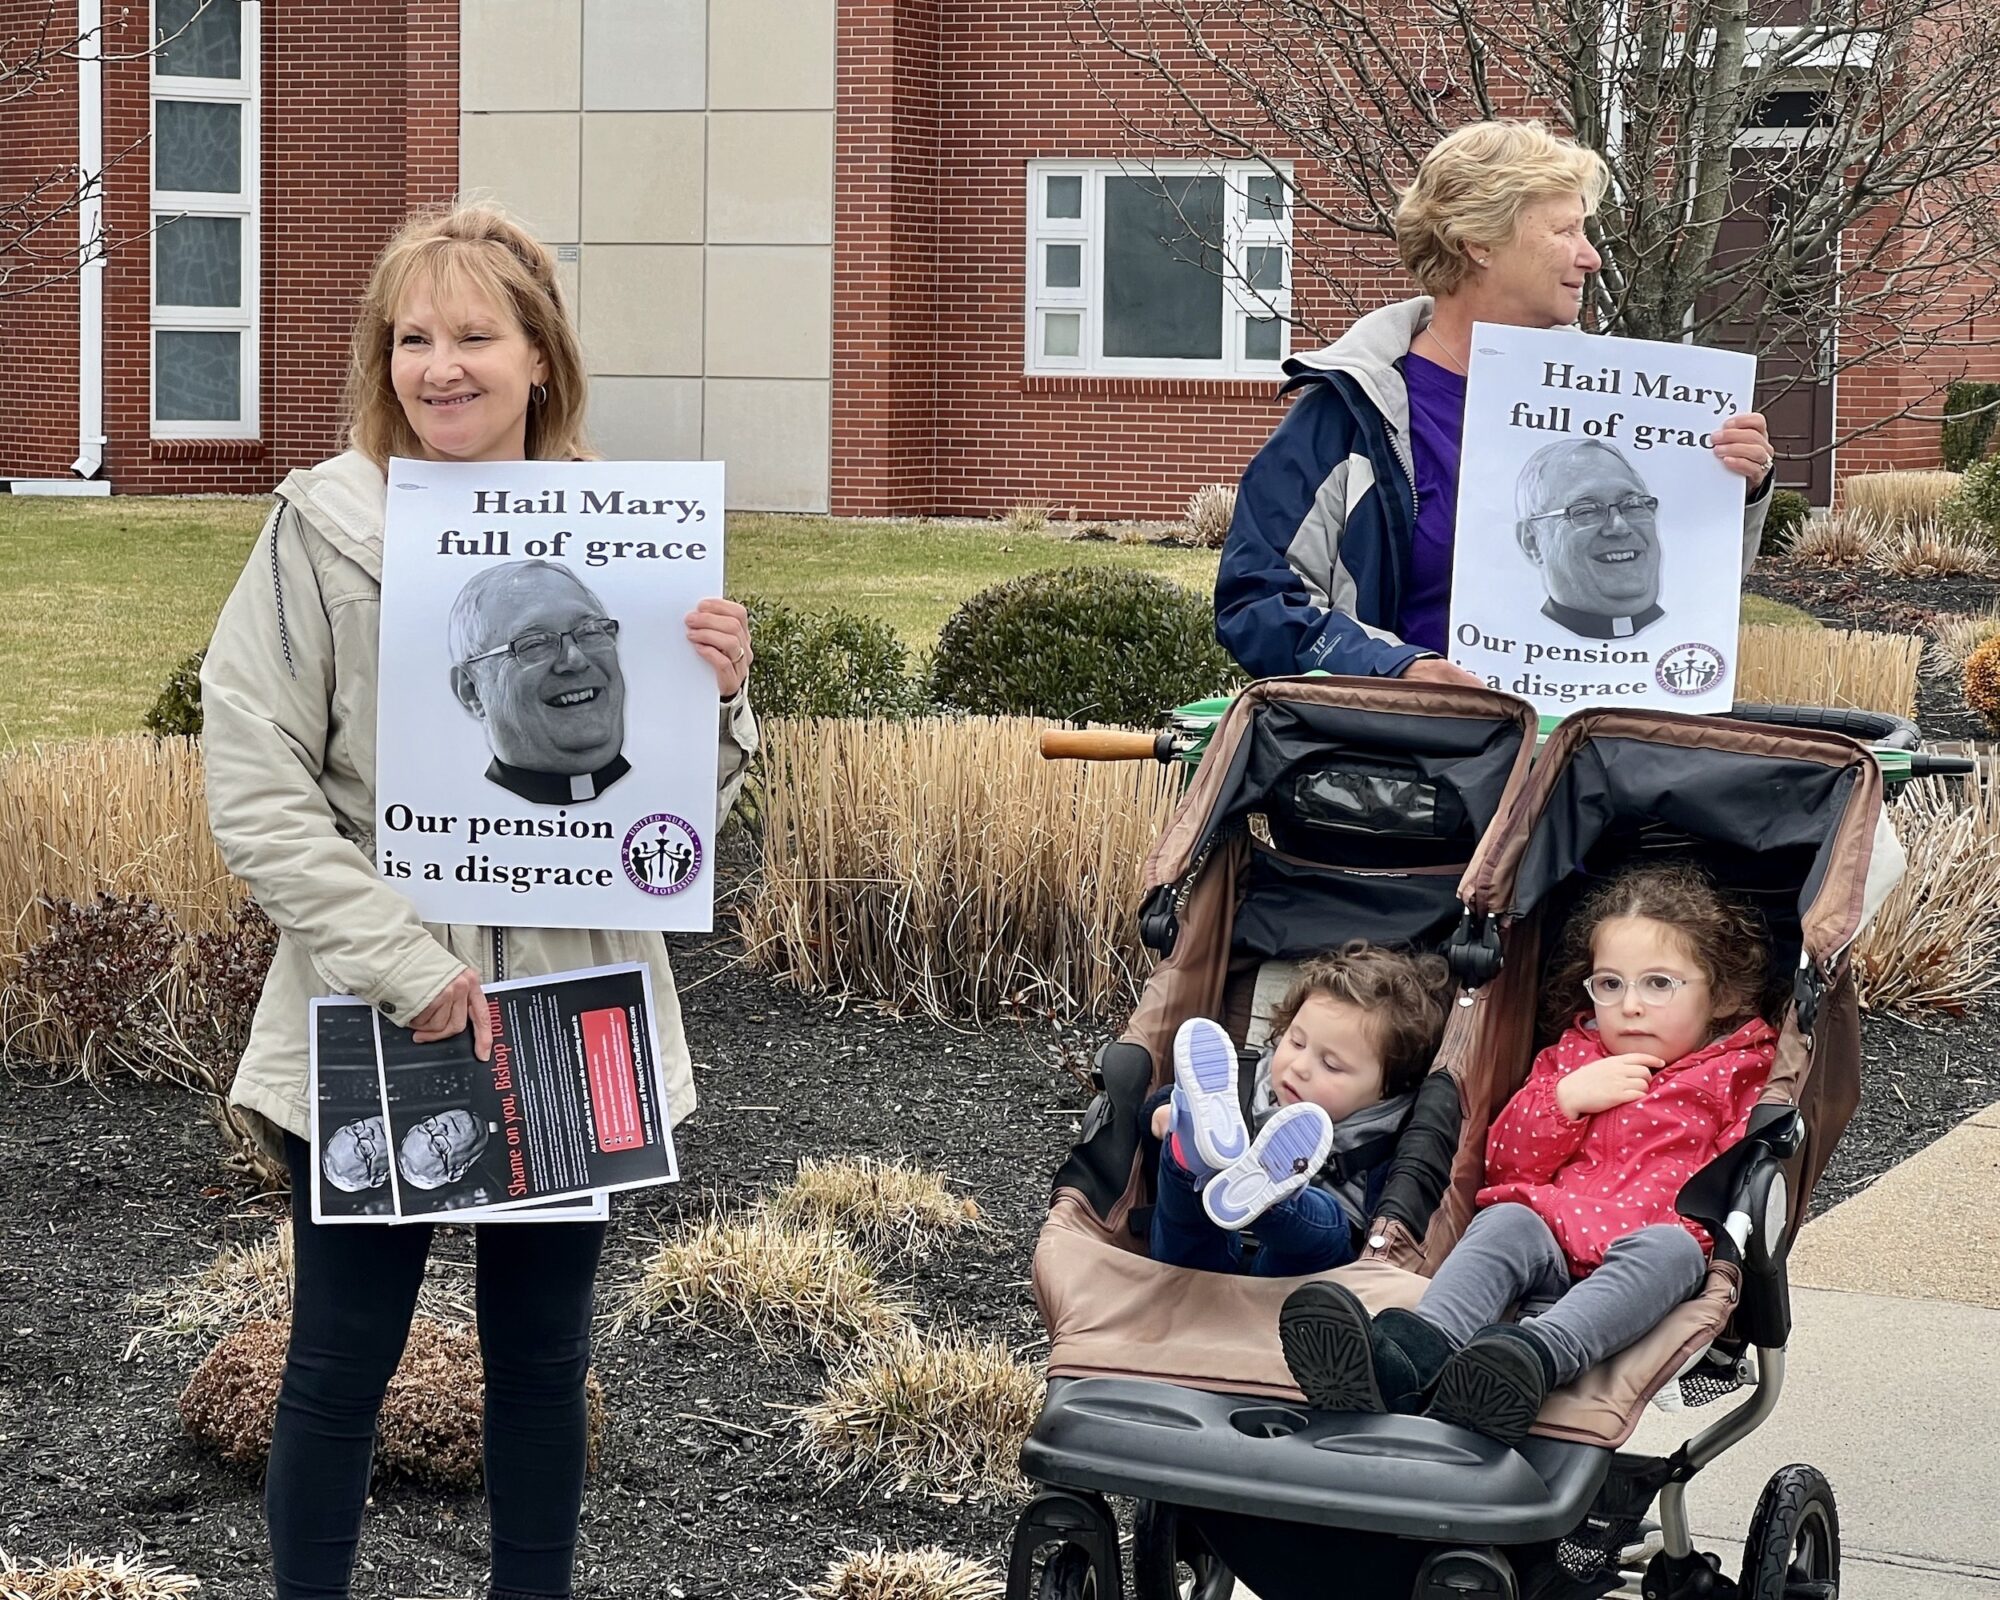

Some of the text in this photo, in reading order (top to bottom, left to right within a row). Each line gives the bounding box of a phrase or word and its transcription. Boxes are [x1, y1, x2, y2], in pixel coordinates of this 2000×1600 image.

[1542, 362, 1736, 415] Hail Mary,
[1510, 403, 1715, 450] full of grac
[473, 491, 705, 523] Hail Mary,
[437, 531, 706, 566] full of grace
[1458, 624, 1648, 664] Our pension
[1486, 674, 1647, 703] a disgrace
[385, 804, 614, 844] Our pension
[629, 814, 695, 838] UNITED NURSES
[384, 850, 613, 893] is a disgrace
[623, 860, 645, 889] ALLIED
[647, 850, 701, 895] PROFESSIONALS
[491, 1043, 512, 1090] Bishop
[503, 1093, 523, 1123] you,
[642, 1103, 650, 1122] more
[506, 1127, 519, 1144] on
[645, 1123, 653, 1144] Learn
[508, 1149, 527, 1196] Shame
